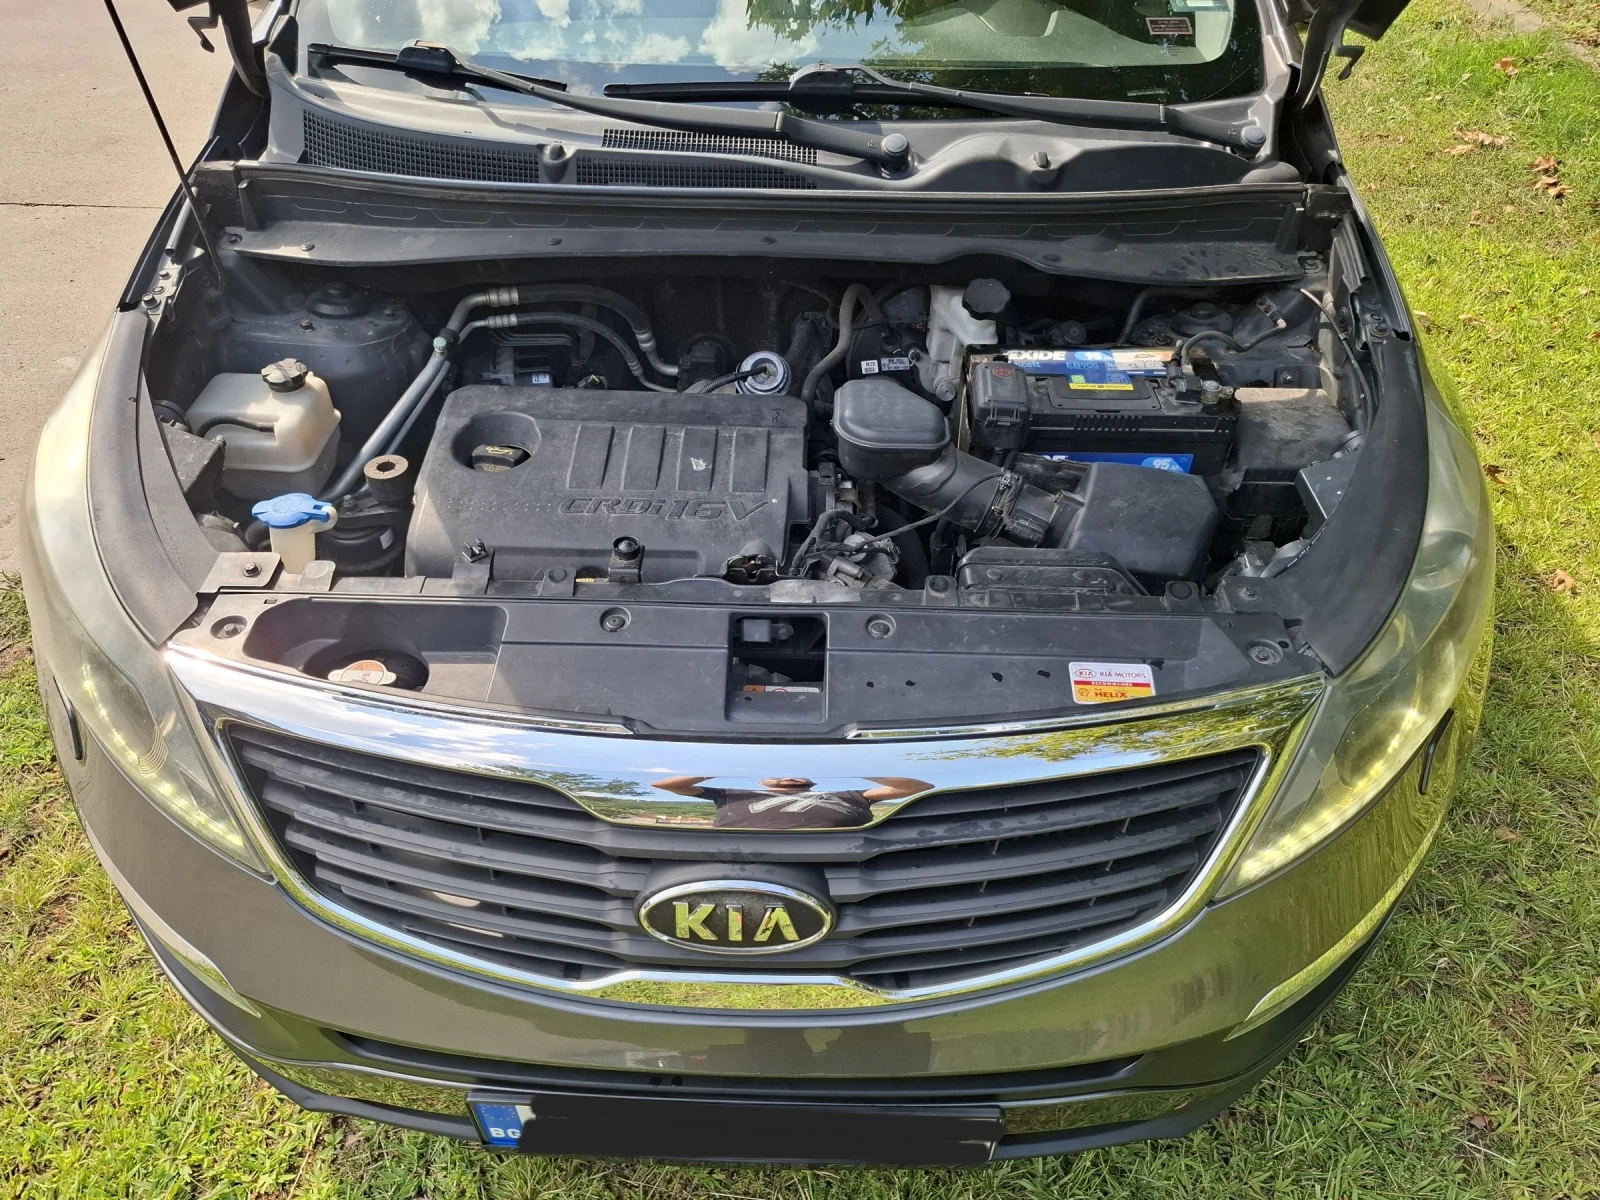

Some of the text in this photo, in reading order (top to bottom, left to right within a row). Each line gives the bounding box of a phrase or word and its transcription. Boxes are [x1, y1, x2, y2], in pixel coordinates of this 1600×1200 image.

[1006, 350, 1066, 361] EXIDE
[1084, 351, 1102, 361] 95
[1152, 459, 1171, 470] 95
[672, 901, 800, 942] KIA
[489, 1127, 522, 1139] BG
